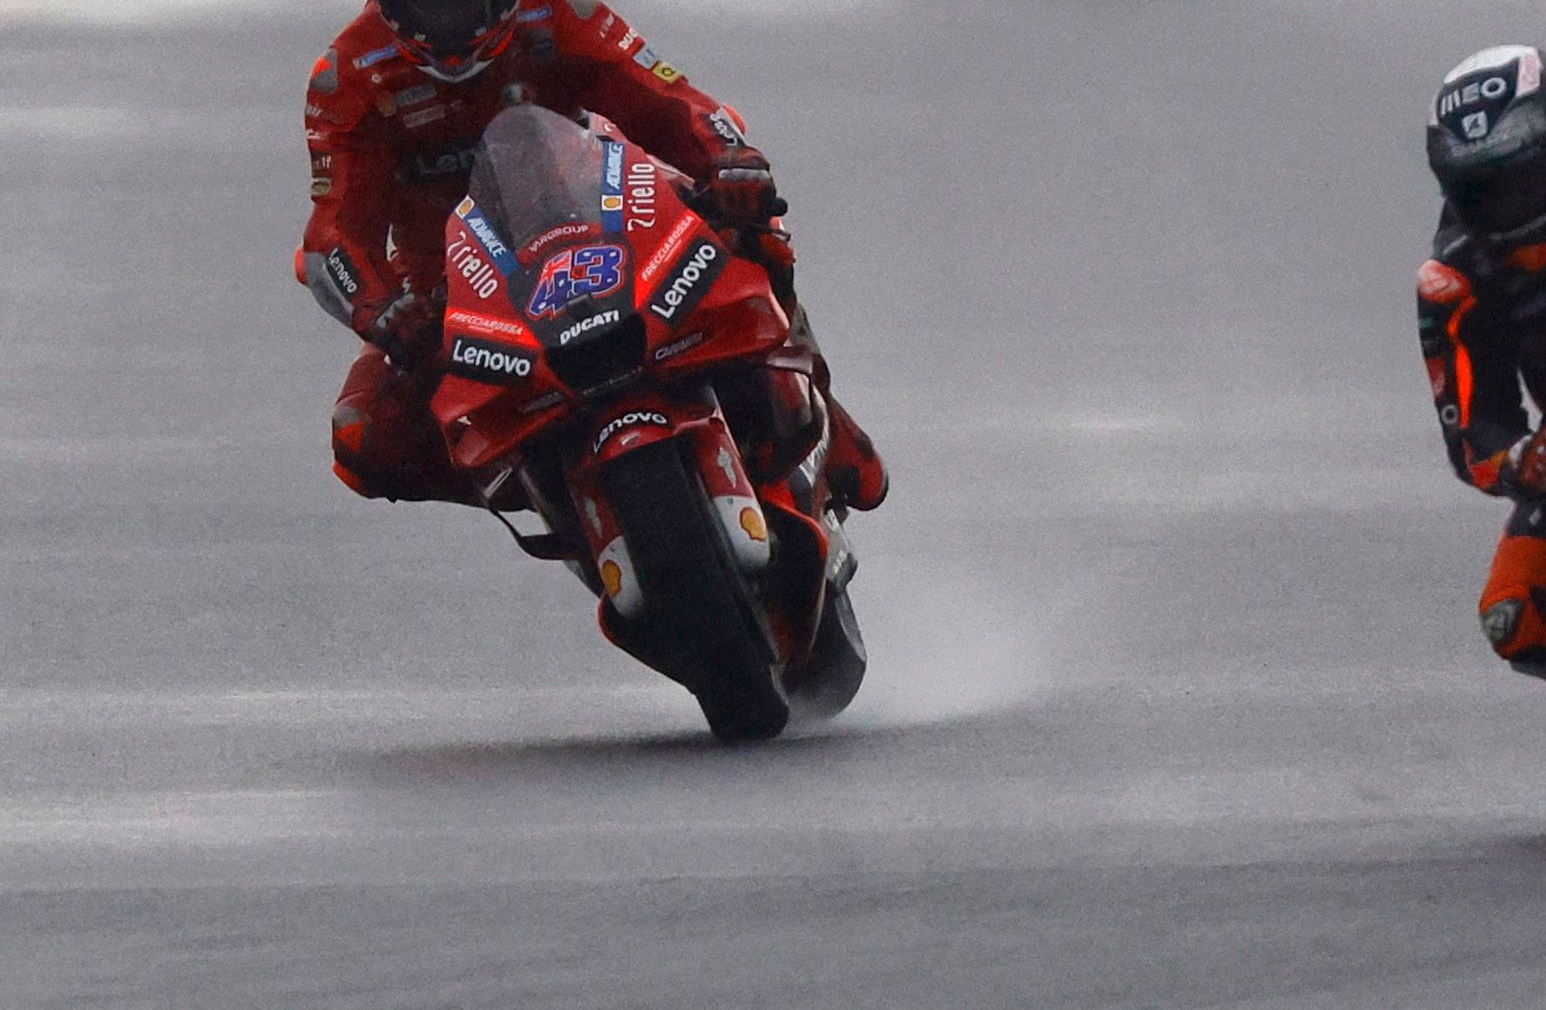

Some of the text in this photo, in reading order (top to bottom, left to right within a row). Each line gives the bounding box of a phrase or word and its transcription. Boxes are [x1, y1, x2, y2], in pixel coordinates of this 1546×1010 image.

[328, 247, 358, 294] Lenovo
[641, 214, 695, 282] FRECCIAROSSA
[527, 244, 625, 318] 43
[650, 243, 717, 320] Lenovo
[560, 309, 620, 346] DUCATI
[452, 338, 532, 377] Lenovo
[592, 411, 668, 454] Lenovo
